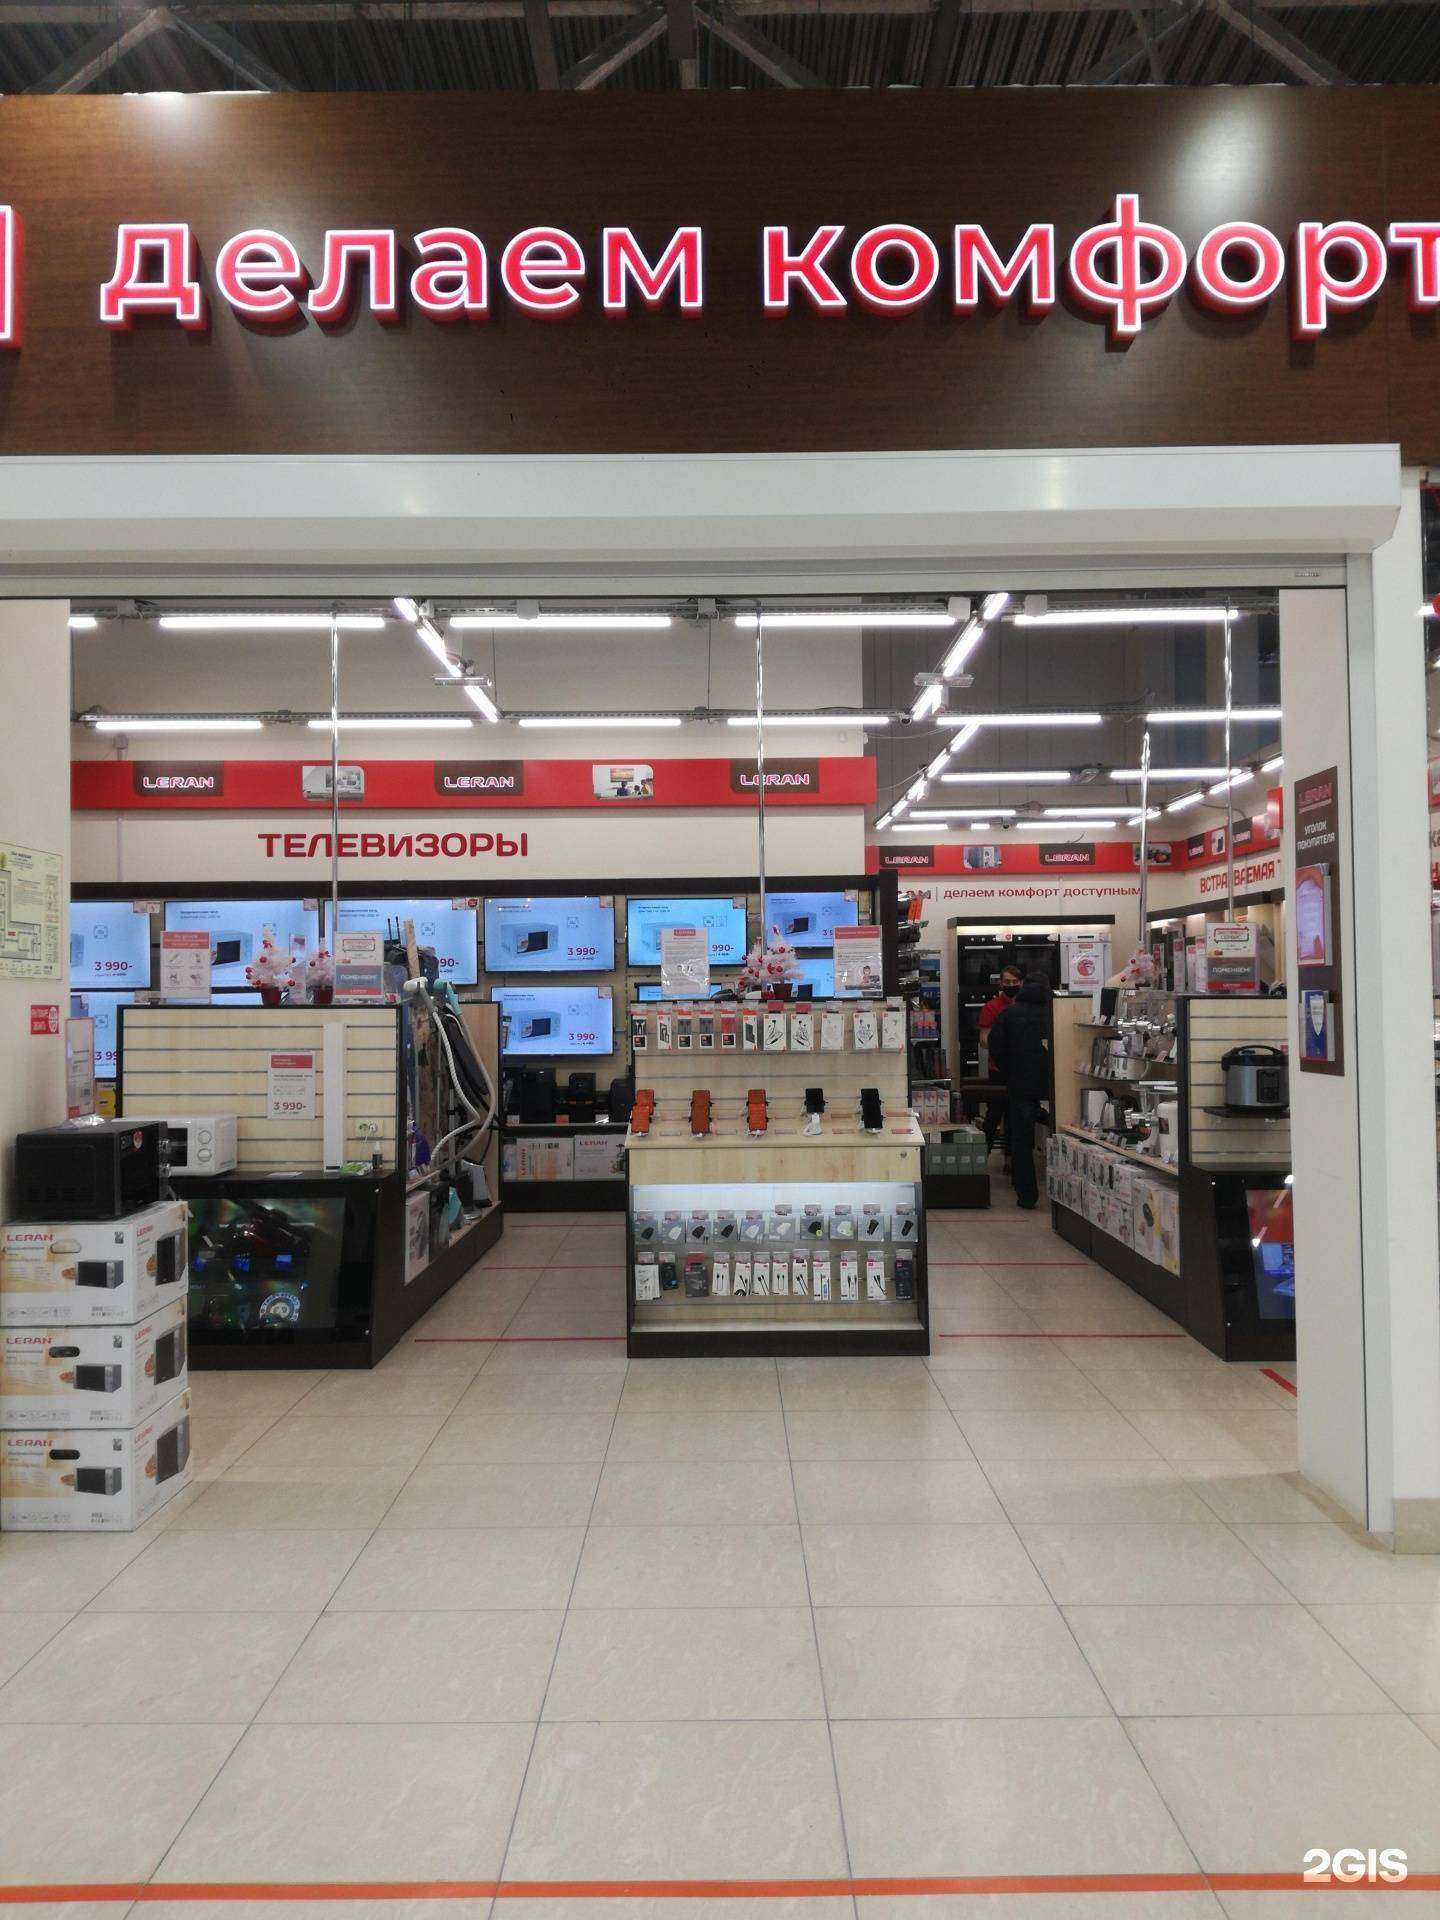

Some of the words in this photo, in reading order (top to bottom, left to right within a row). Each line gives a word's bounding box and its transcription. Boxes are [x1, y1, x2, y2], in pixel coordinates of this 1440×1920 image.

[100, 222, 702, 324] делаем
[762, 193, 1440, 333] комфорт
[142, 776, 214, 788] LERAN
[444, 776, 515, 788] LERAN
[740, 773, 810, 786] LERAN
[257, 832, 528, 858] ТЕЛЕВИЗОРЫ
[885, 855, 929, 864] LERAN
[1045, 853, 1090, 862] LERAN
[1200, 861, 1275, 893] ВСТРАВАЕМАЯ
[943, 888, 994, 899] делаем
[998, 887, 1060, 899] комфорт
[1063, 887, 1141, 899] доступным
[7, 1234, 54, 1242] LERAN
[6, 1336, 53, 1345] LERAN
[7, 1439, 54, 1447] LERAN
